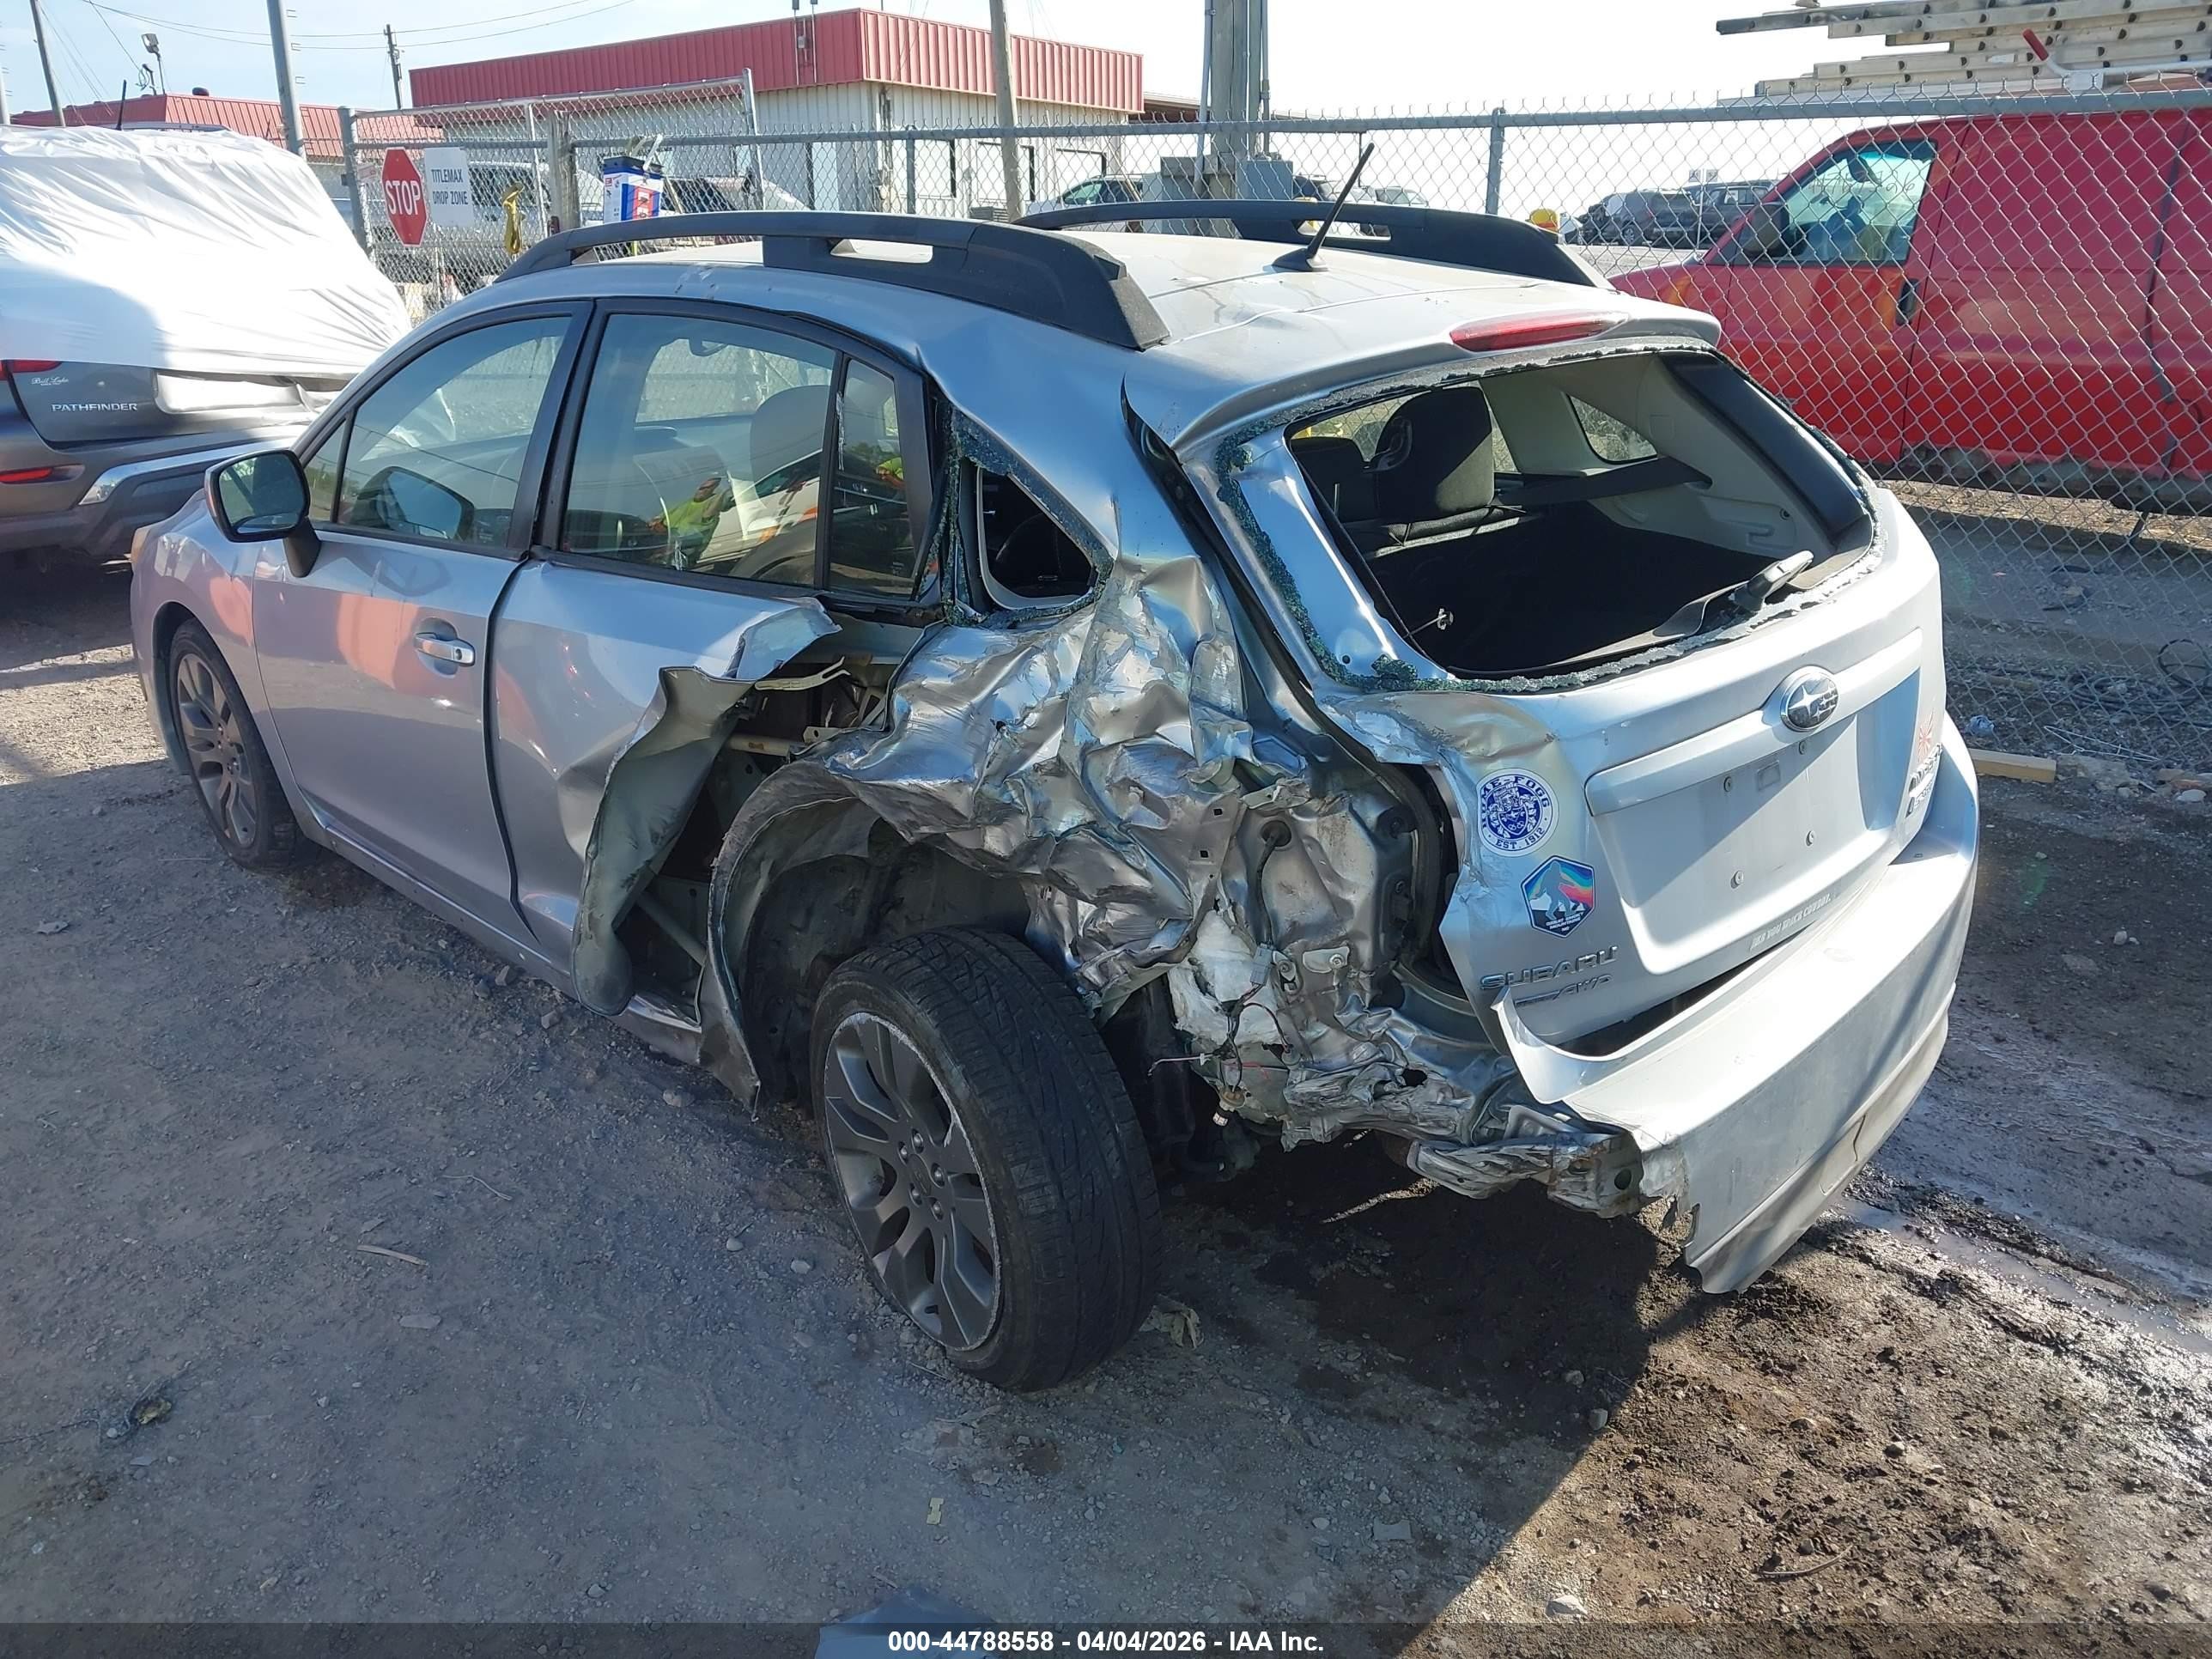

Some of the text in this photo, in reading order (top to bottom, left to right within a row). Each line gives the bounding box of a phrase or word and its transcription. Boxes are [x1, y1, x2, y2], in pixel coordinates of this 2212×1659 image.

[431, 168, 464, 183] TITLEMAX
[385, 179, 422, 216] STOP
[432, 191, 469, 205] DROP ZONE
[51, 403, 138, 412] PATHFINDER
[1495, 827, 1546, 850] EST. 1912
[1480, 945, 1619, 990] SUBARU
